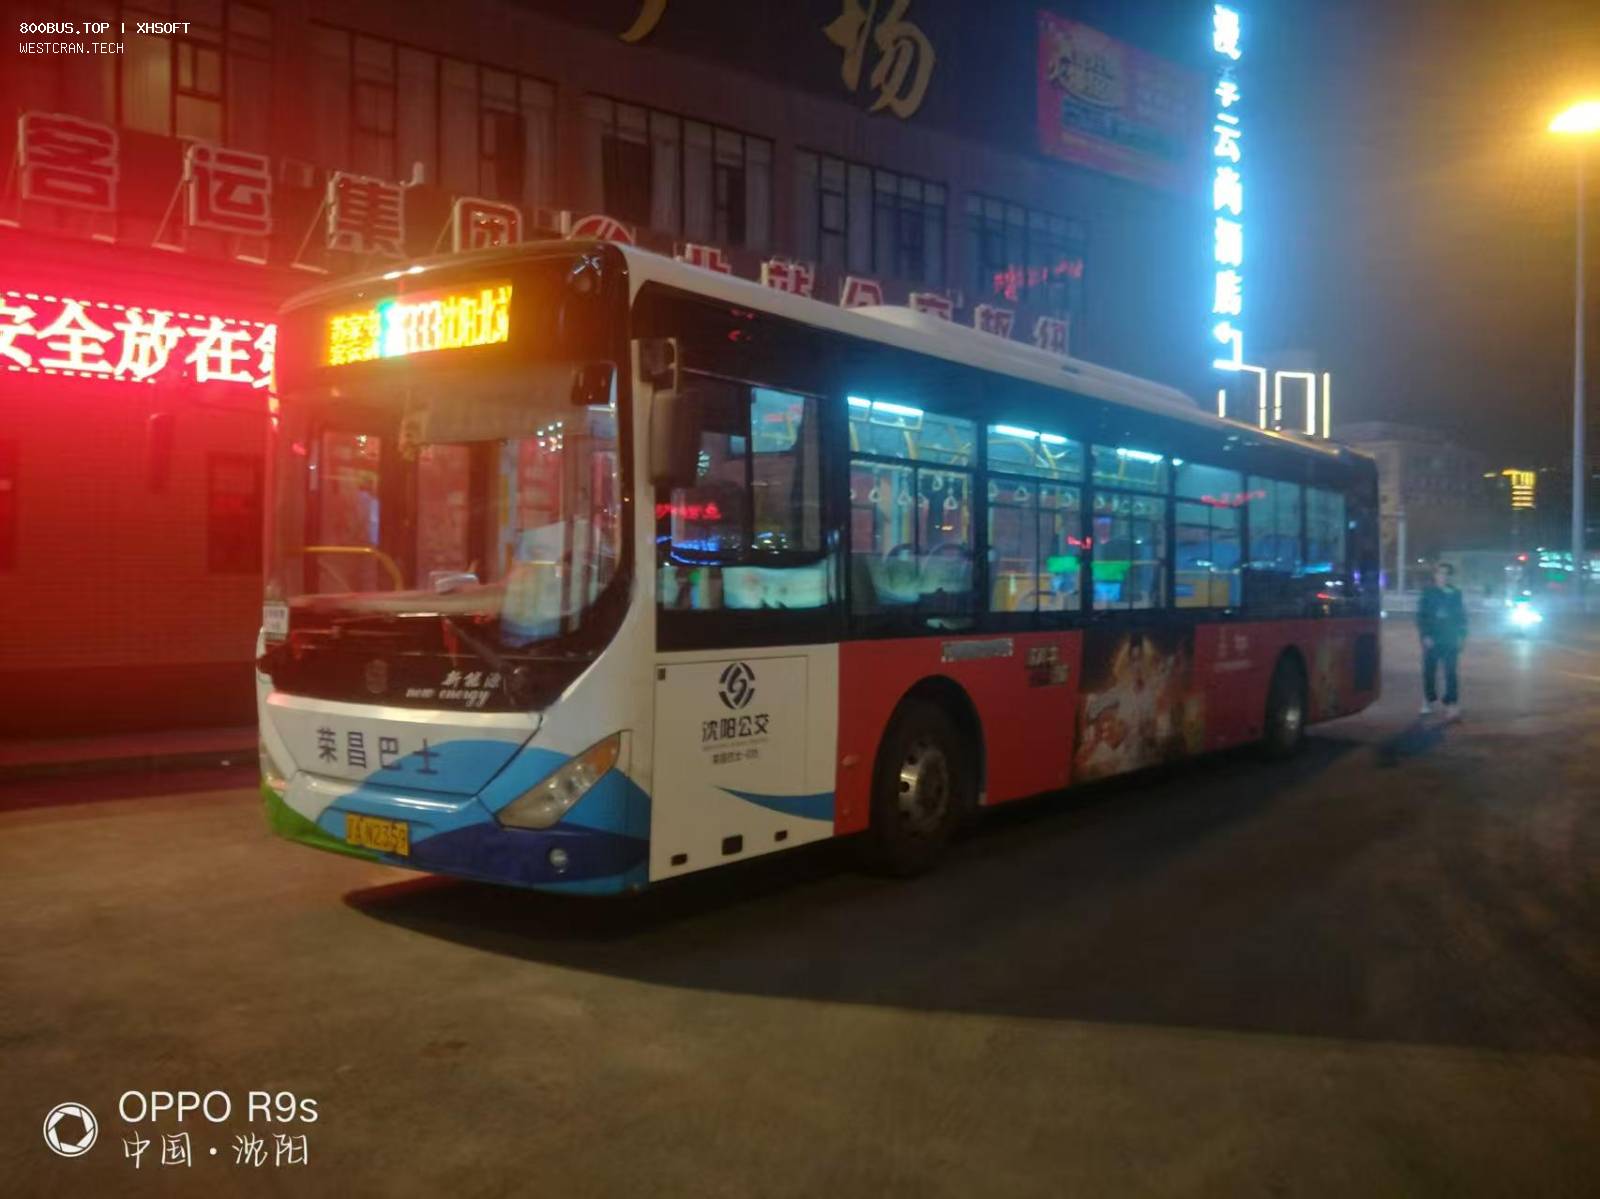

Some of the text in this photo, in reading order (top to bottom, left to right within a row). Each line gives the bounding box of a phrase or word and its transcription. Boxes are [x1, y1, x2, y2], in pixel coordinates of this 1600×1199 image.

[17, 109, 523, 258] 客运集团
[438, 688, 491, 707] energy
[701, 713, 770, 743] 沈阳公交
[315, 726, 439, 775] 荣昌巴士
